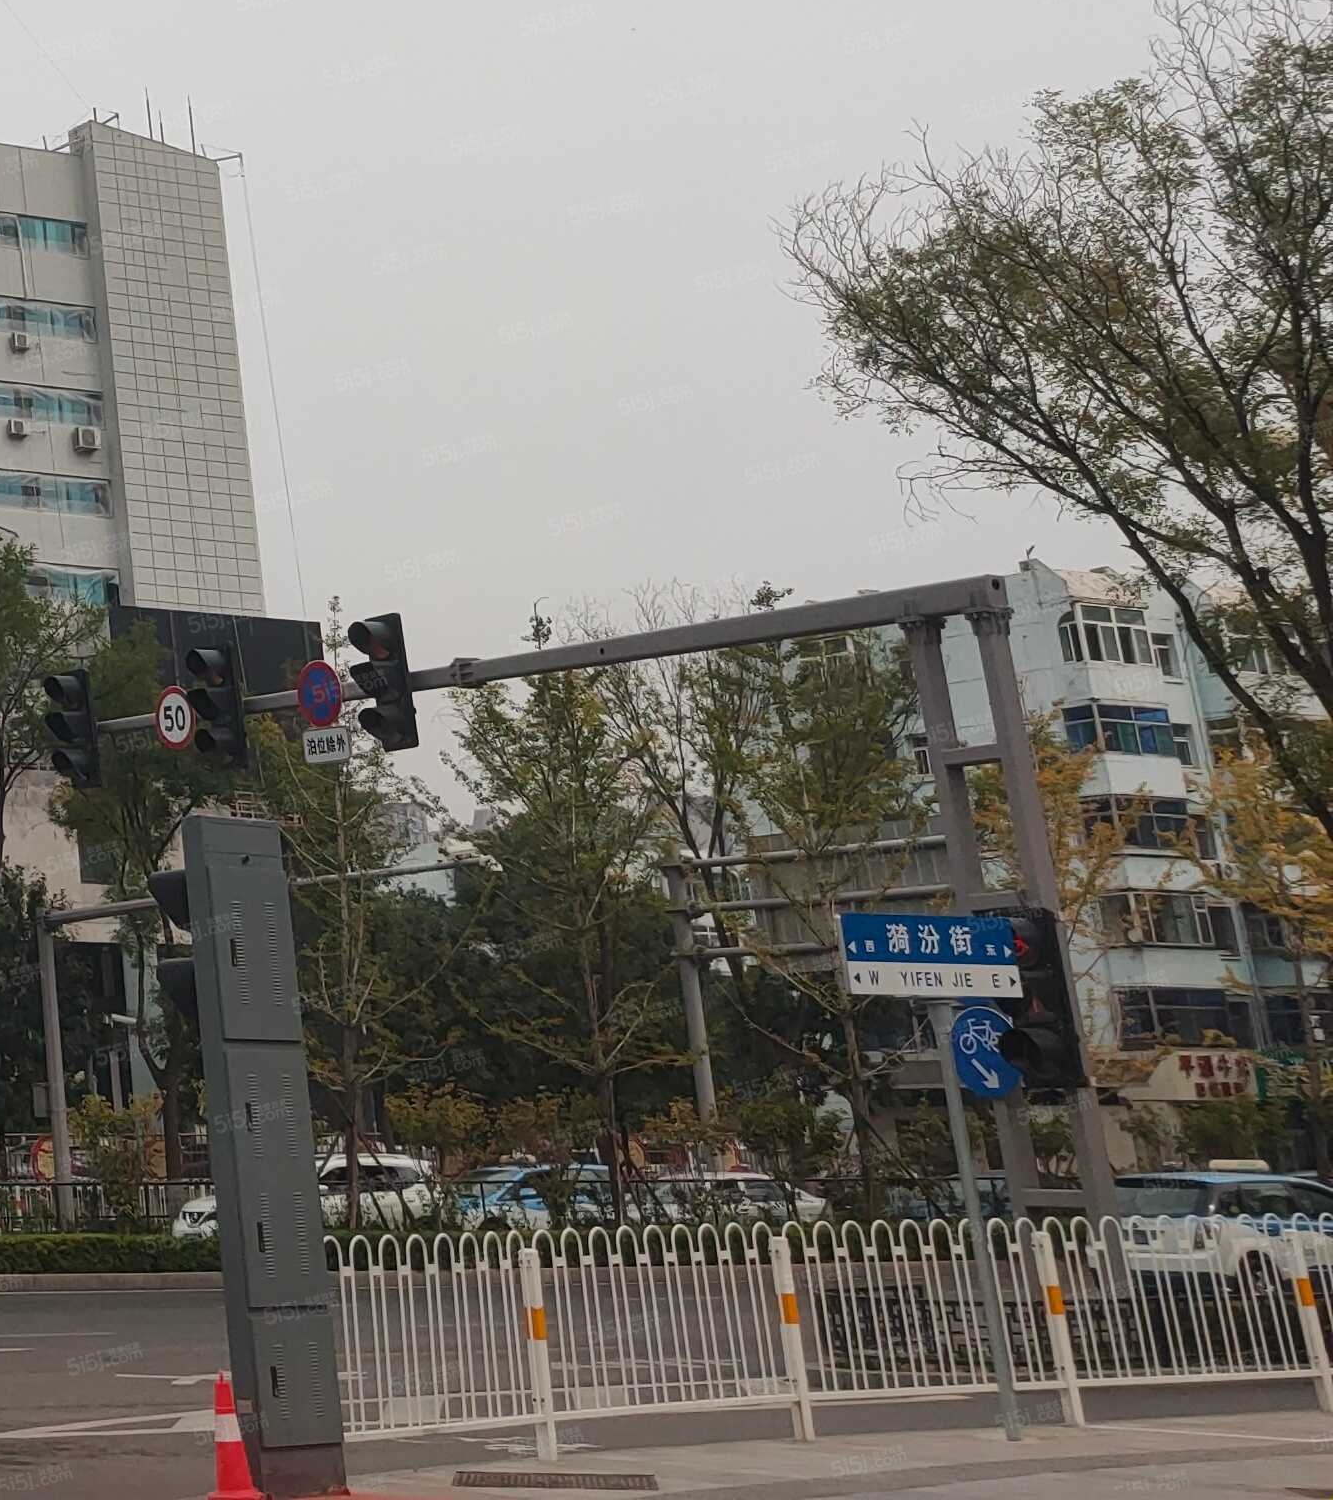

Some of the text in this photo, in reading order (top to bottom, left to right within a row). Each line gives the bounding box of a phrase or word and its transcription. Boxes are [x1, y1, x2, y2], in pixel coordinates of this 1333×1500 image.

[163, 705, 186, 732] 50
[306, 733, 346, 757] 泊位除外
[885, 923, 973, 956] 漪汾街
[868, 970, 1001, 988] W YIFEN JIE E
